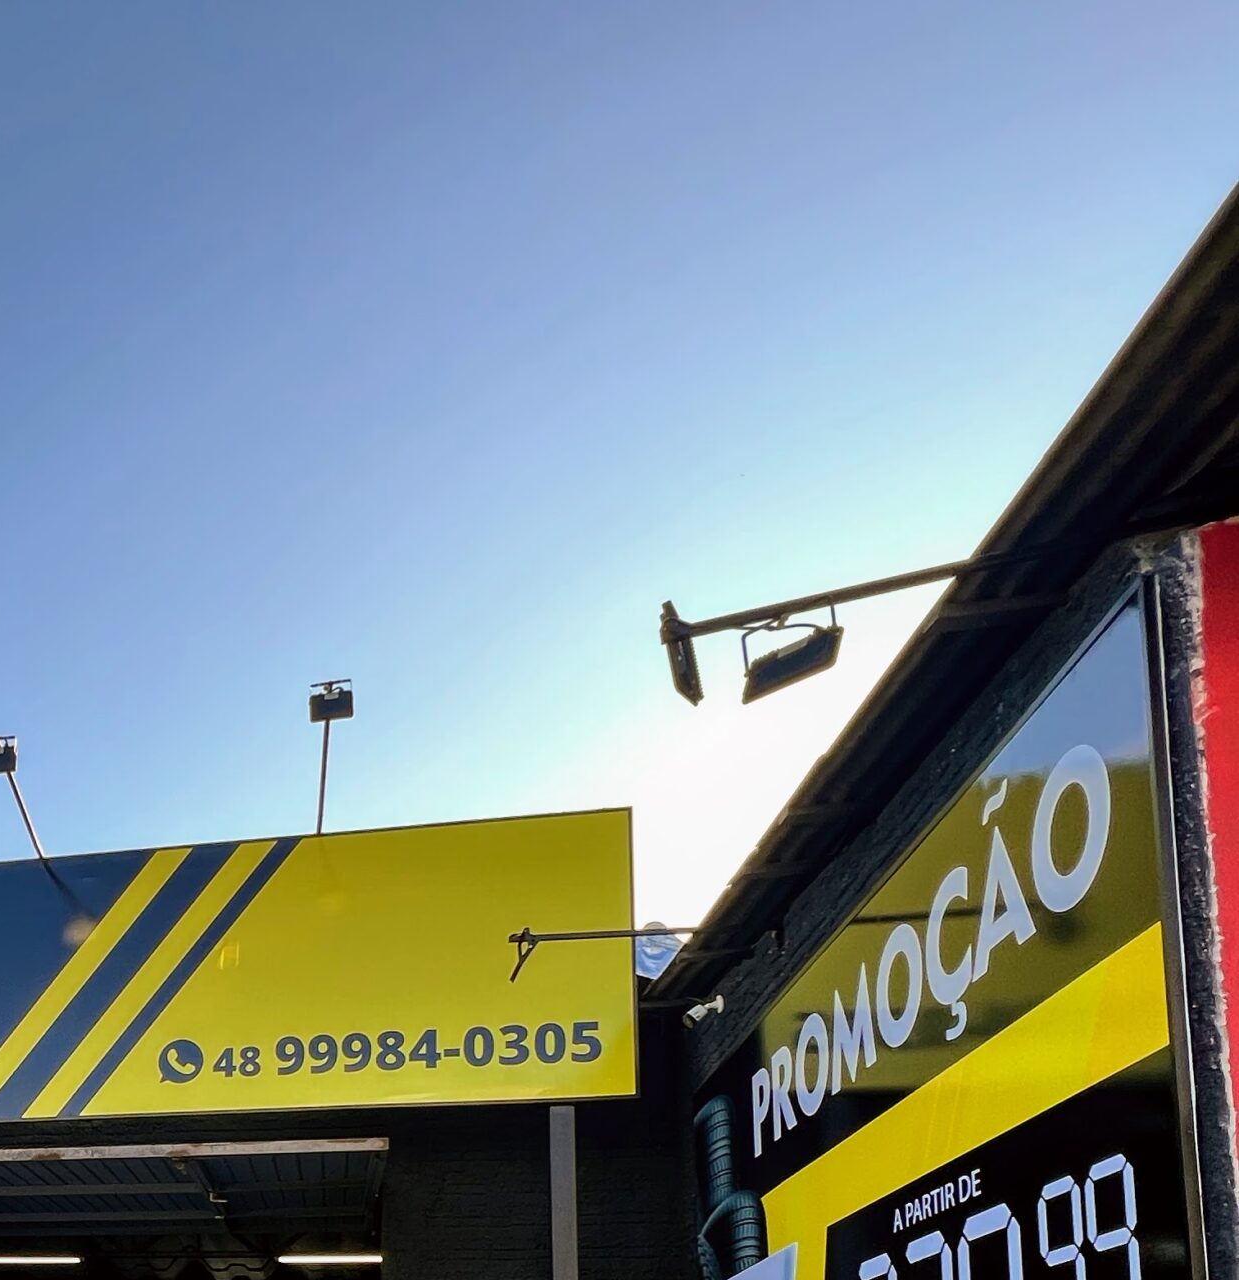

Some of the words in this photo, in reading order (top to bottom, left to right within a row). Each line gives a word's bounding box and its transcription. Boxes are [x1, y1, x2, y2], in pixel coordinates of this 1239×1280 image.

[751, 744, 1111, 1157] PROMOÇÃO
[213, 1045, 261, 1078] 48
[276, 1020, 603, 1075] 99984-0305
[893, 1208, 904, 1233] A
[905, 1182, 956, 1227] PARTIR
[958, 1168, 982, 1203] DE
